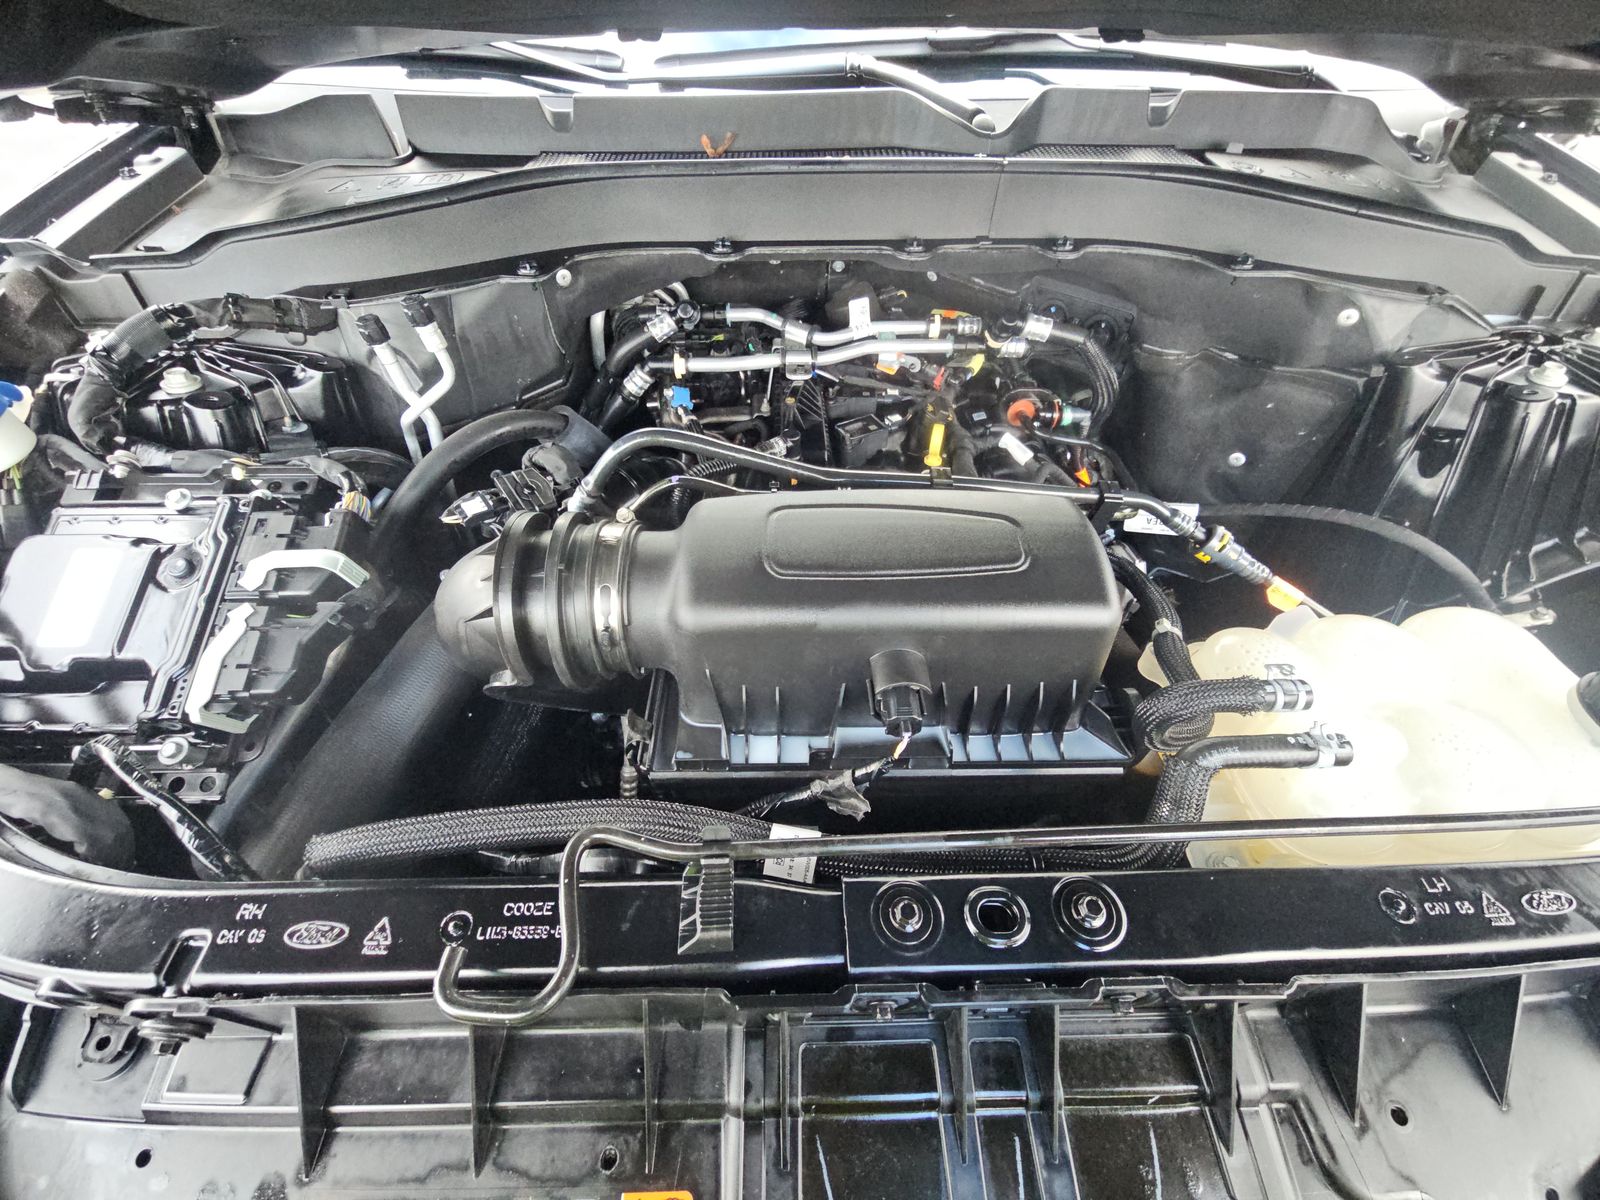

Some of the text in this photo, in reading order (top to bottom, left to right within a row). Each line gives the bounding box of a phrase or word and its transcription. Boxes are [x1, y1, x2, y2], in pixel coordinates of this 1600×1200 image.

[1420, 877, 1452, 893] LH
[235, 903, 268, 920] RH
[1424, 902, 1450, 915] CAV
[289, 922, 343, 946] Ford
